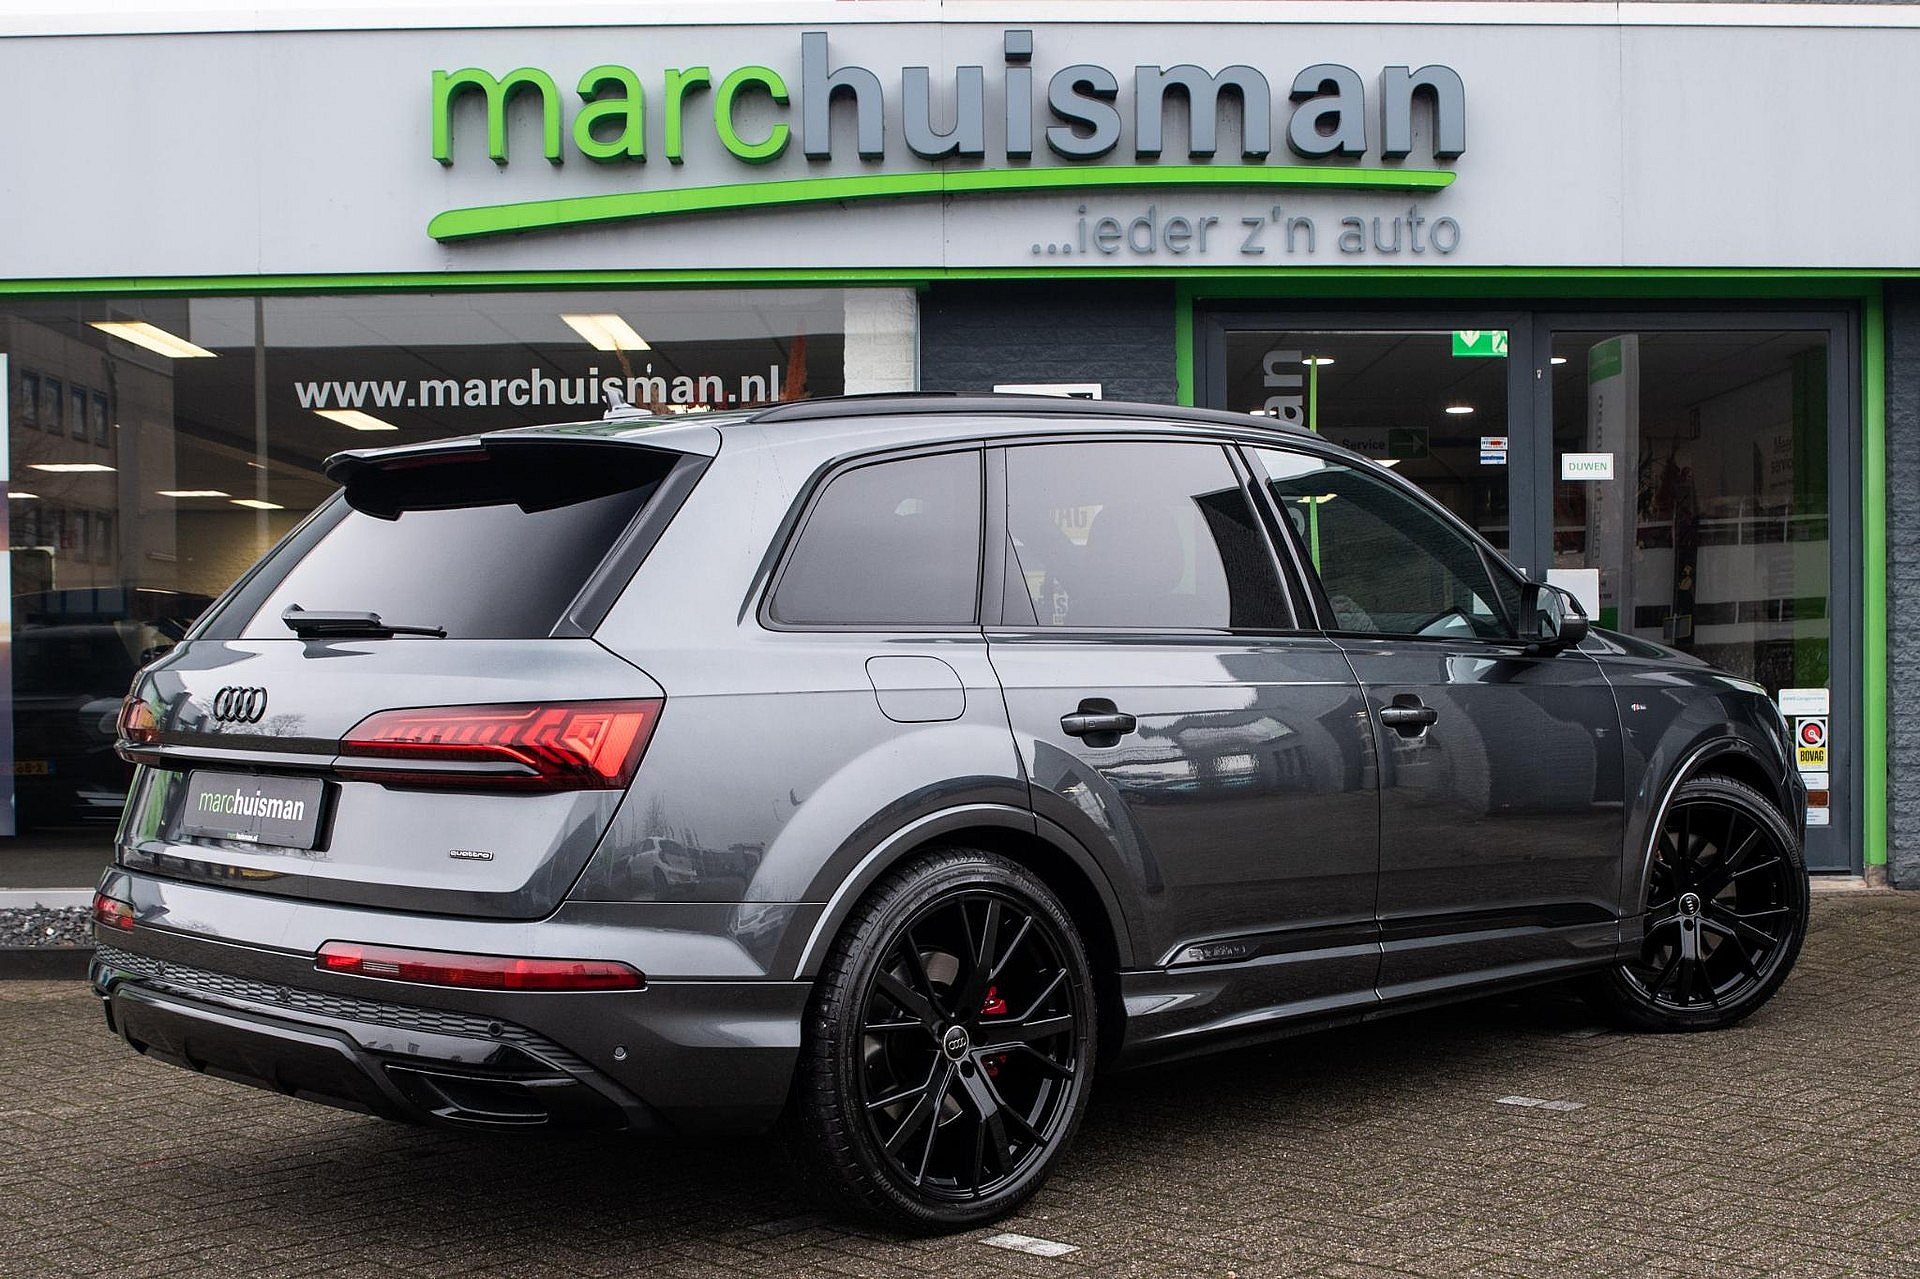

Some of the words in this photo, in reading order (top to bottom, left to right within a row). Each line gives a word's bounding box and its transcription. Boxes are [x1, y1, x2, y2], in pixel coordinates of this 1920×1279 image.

[431, 30, 1466, 166] marchuisman
[1240, 205, 1316, 255] z'n
[1338, 204, 1462, 255] auto
[294, 365, 779, 409] www.marchuisman.nl
[1568, 462, 1608, 471] DUWEN
[1800, 750, 1824, 762] BOVAG
[198, 788, 305, 821] marchuisman
